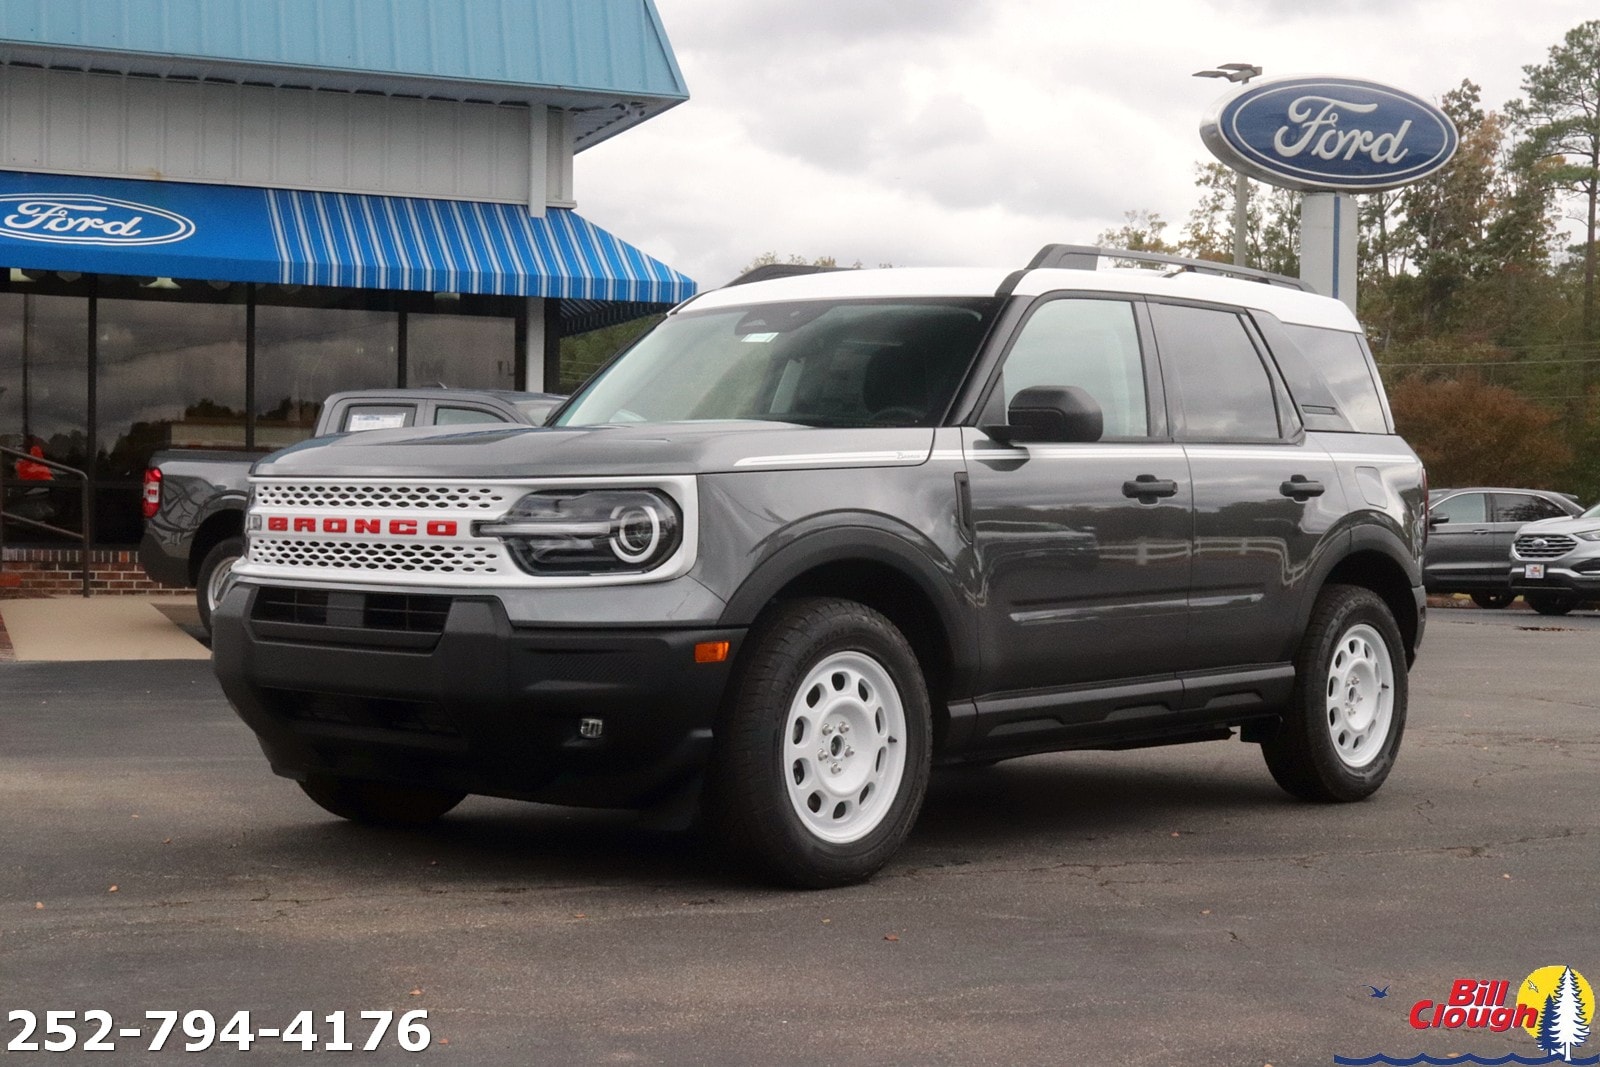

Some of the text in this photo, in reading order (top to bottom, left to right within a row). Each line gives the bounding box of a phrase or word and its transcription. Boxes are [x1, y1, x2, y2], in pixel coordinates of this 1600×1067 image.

[1274, 96, 1412, 164] Ford
[4, 202, 142, 236] Ford
[268, 517, 457, 536] BRONCO
